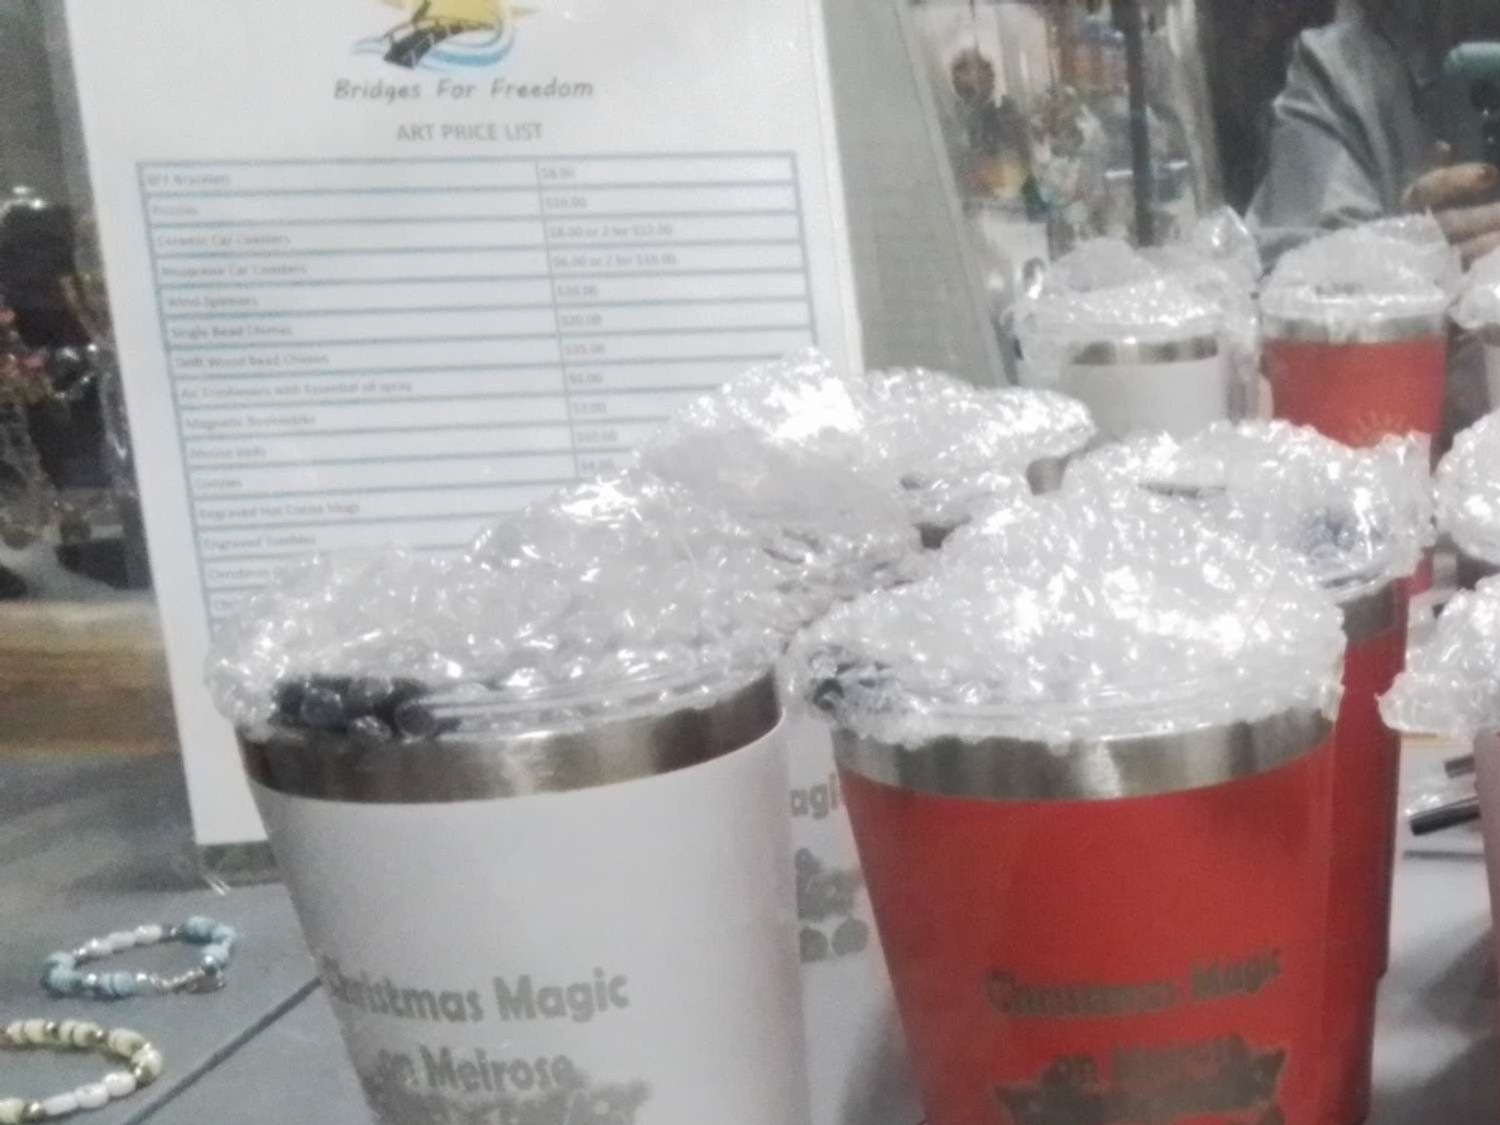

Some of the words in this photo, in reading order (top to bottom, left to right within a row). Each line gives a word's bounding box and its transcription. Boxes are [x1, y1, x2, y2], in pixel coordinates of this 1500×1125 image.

[334, 77, 421, 103] Bridges
[436, 77, 477, 99] For
[491, 76, 594, 98] Freedom
[396, 122, 436, 141] ART
[442, 122, 496, 141] PRICE
[505, 121, 543, 140] LIST
[493, 965, 631, 1023] Magic
